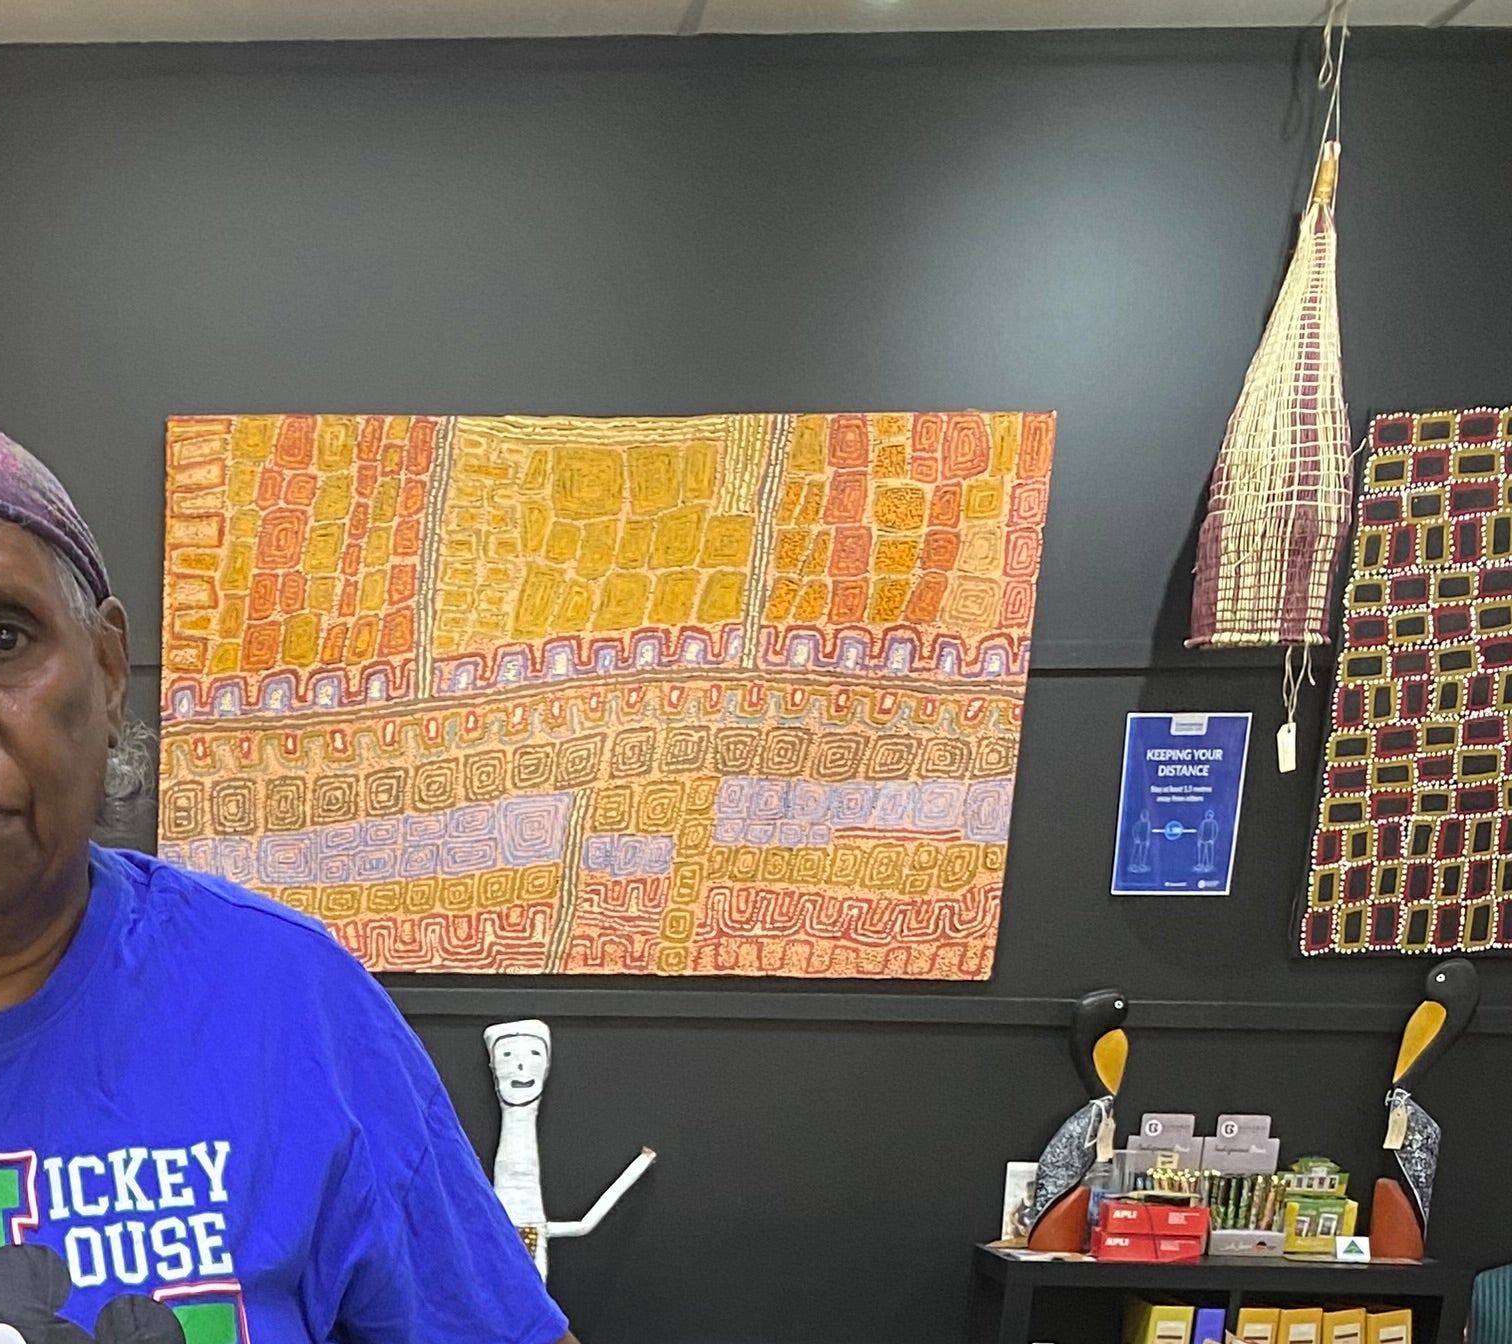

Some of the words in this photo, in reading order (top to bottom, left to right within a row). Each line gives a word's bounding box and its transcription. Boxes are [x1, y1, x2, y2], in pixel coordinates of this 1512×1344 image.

[1147, 749, 1191, 760] KEEPING
[1193, 749, 1223, 760] YOUR
[1158, 765, 1210, 776] DISTANCE
[43, 1140, 231, 1221] ICKEY
[1112, 1210, 1137, 1219] APLI
[1105, 1237, 1129, 1246] APLI
[64, 1212, 234, 1288] OUSE
